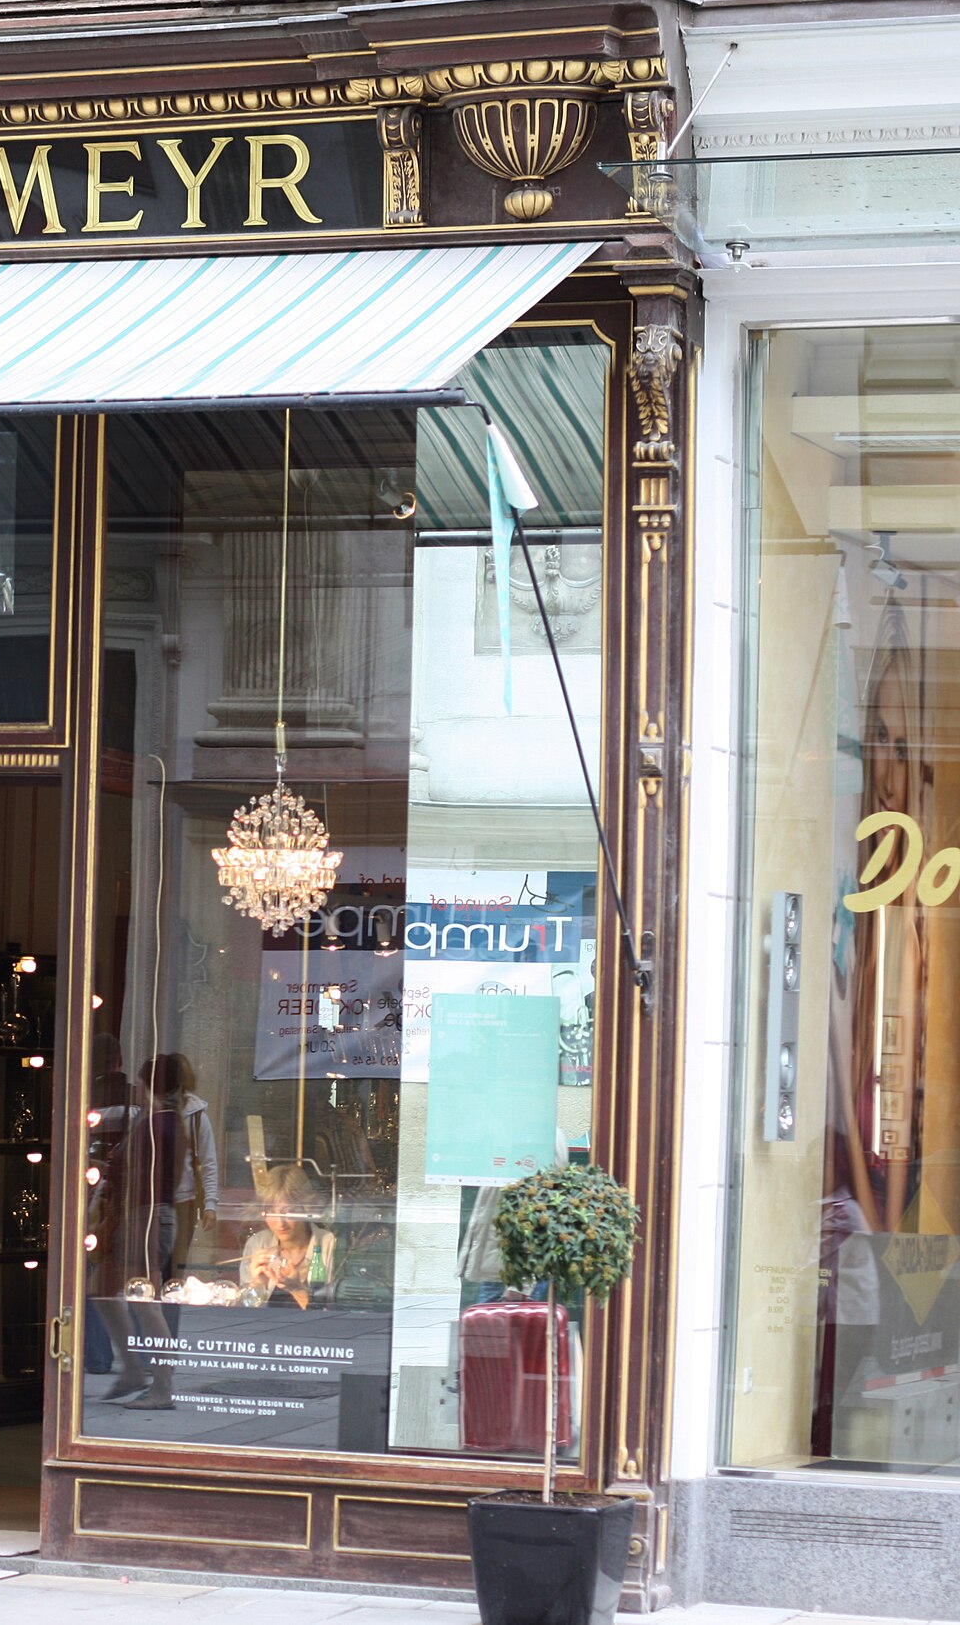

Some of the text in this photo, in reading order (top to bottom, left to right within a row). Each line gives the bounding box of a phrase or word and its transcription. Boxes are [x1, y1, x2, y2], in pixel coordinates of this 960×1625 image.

[127, 1335, 355, 1360] BLOWING, CUTTING & ENGRAVING
[150, 1357, 157, 1365] A
[159, 1358, 187, 1369] project
[188, 1359, 199, 1369] by
[200, 1360, 219, 1368] MAX
[221, 1361, 245, 1370] LAMB
[246, 1362, 259, 1371] for
[270, 1364, 277, 1372] &
[289, 1365, 329, 1375] LOBMEYR
[230, 1397, 256, 1406] VIENNA
[258, 1399, 284, 1408] DESIGN
[285, 1401, 305, 1409] WEEK
[229, 1406, 256, 1415] October
[257, 1408, 277, 1416] 2009
